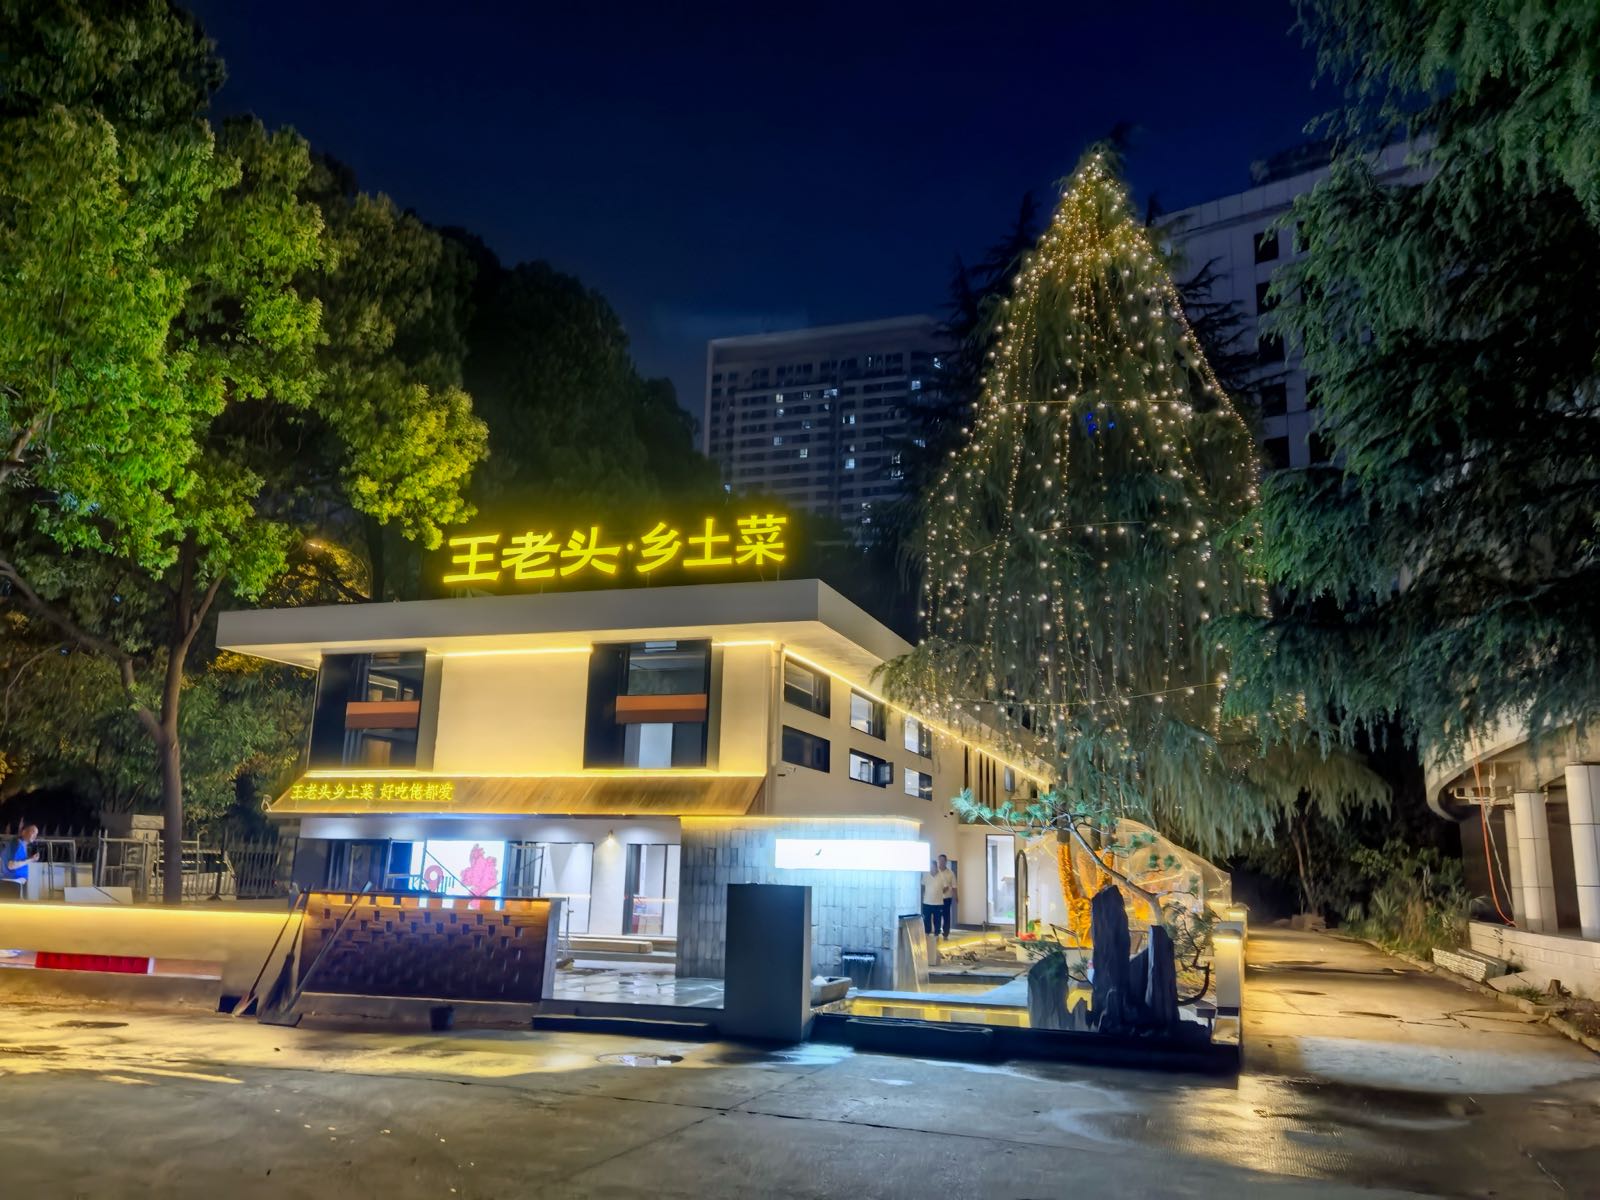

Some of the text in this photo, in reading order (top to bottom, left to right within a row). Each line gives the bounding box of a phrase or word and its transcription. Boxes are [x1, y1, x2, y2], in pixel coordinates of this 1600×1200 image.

[443, 513, 787, 584] 王老头·乡土菜
[290, 783, 374, 800] 王老头乡土菜
